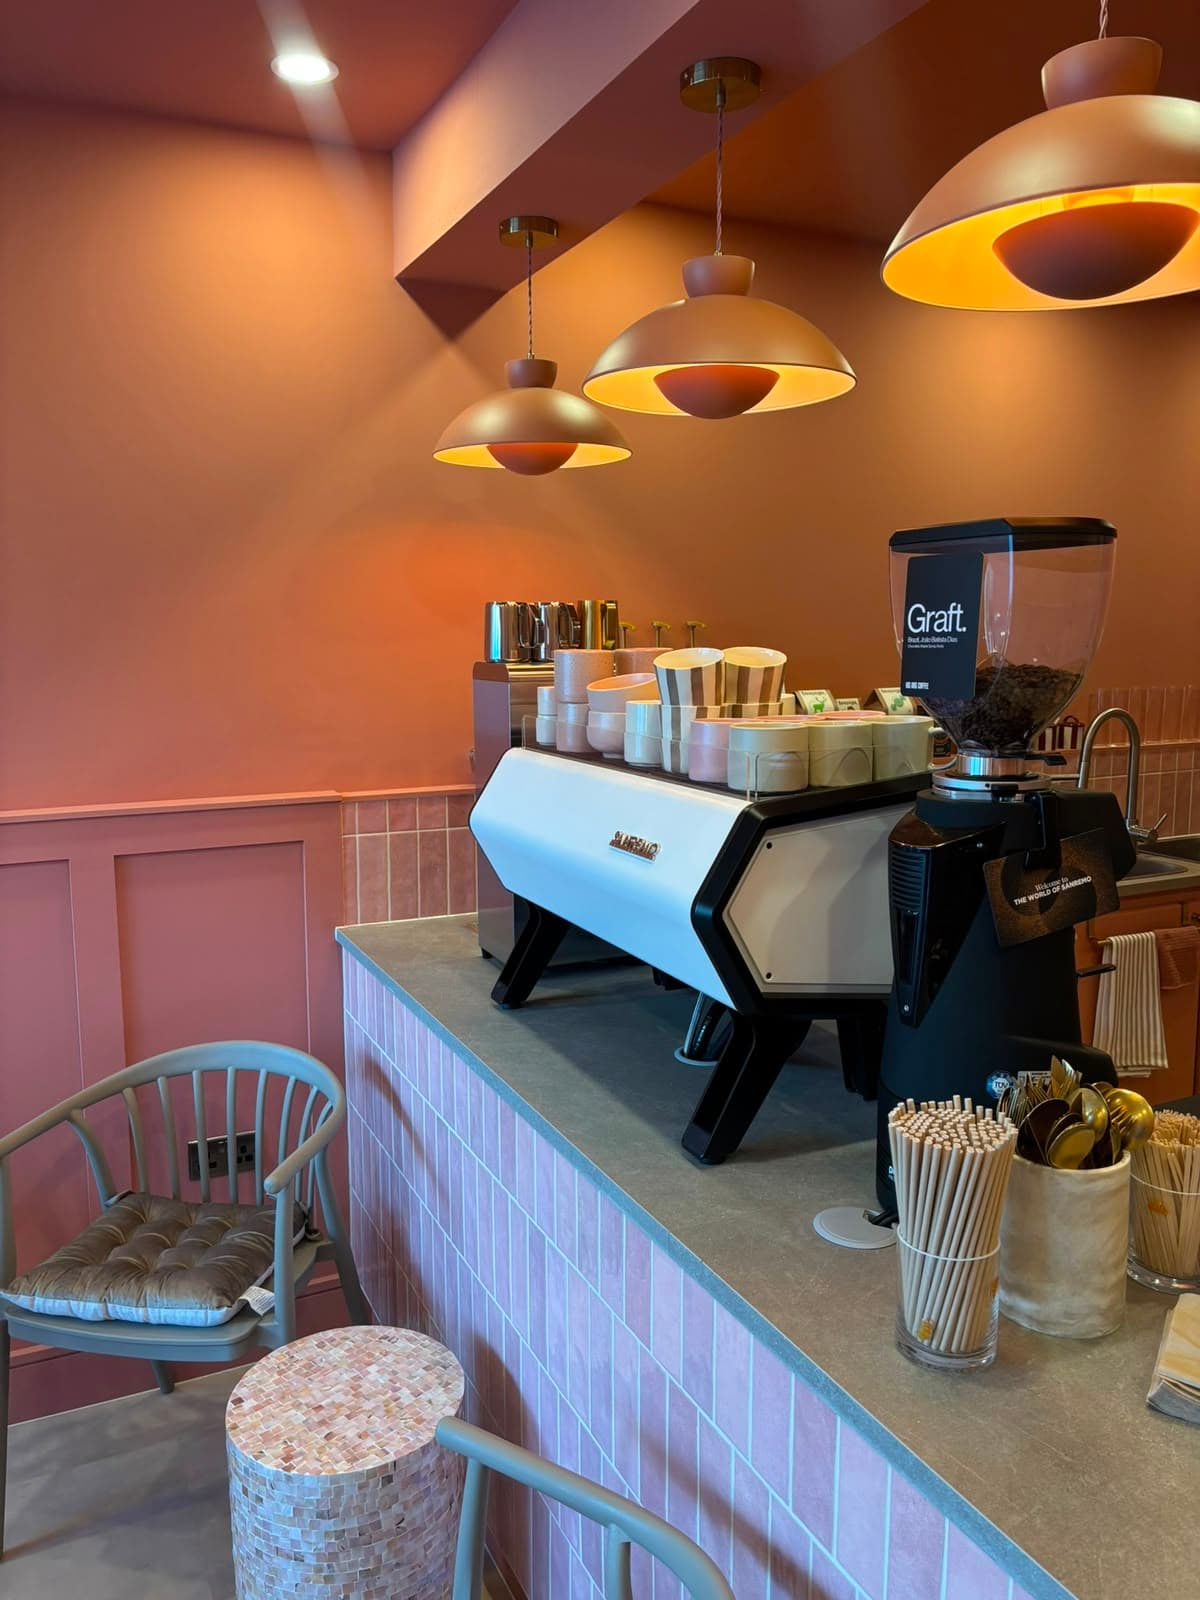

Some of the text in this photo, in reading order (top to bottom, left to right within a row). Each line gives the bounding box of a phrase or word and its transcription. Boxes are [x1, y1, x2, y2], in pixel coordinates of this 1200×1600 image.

[907, 602, 967, 633] Graft.
[1013, 875, 1092, 906] THE WORLD OF SANREMO
[1034, 879, 1061, 892] Welcome
